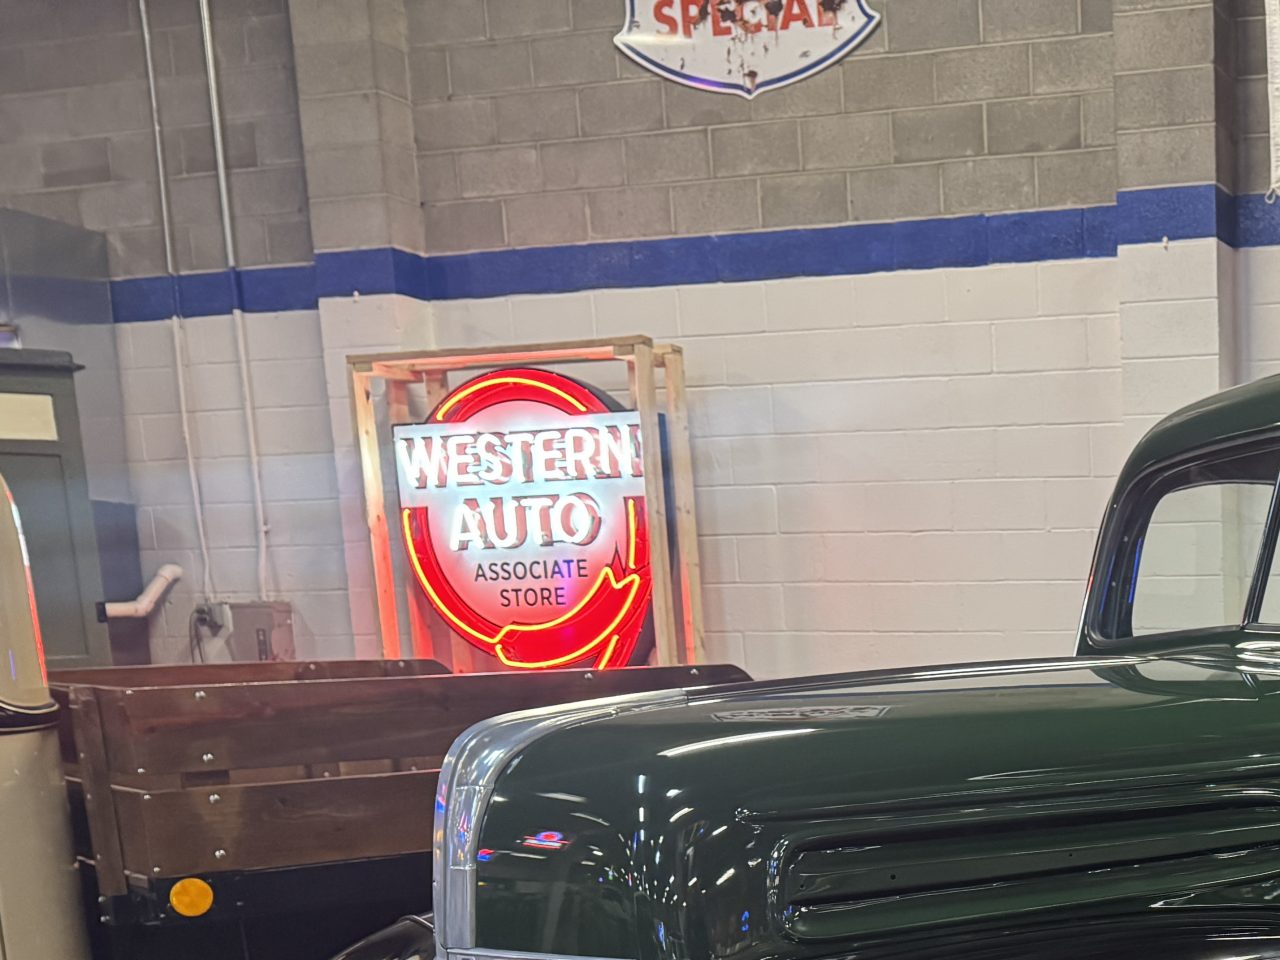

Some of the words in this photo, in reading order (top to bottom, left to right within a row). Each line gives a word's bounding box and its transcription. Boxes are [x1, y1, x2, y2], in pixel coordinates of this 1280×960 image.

[397, 423, 643, 489] WESTERN
[451, 492, 602, 551] AUTO
[474, 559, 589, 582] ASSOCIATE
[500, 587, 566, 608] STORE
